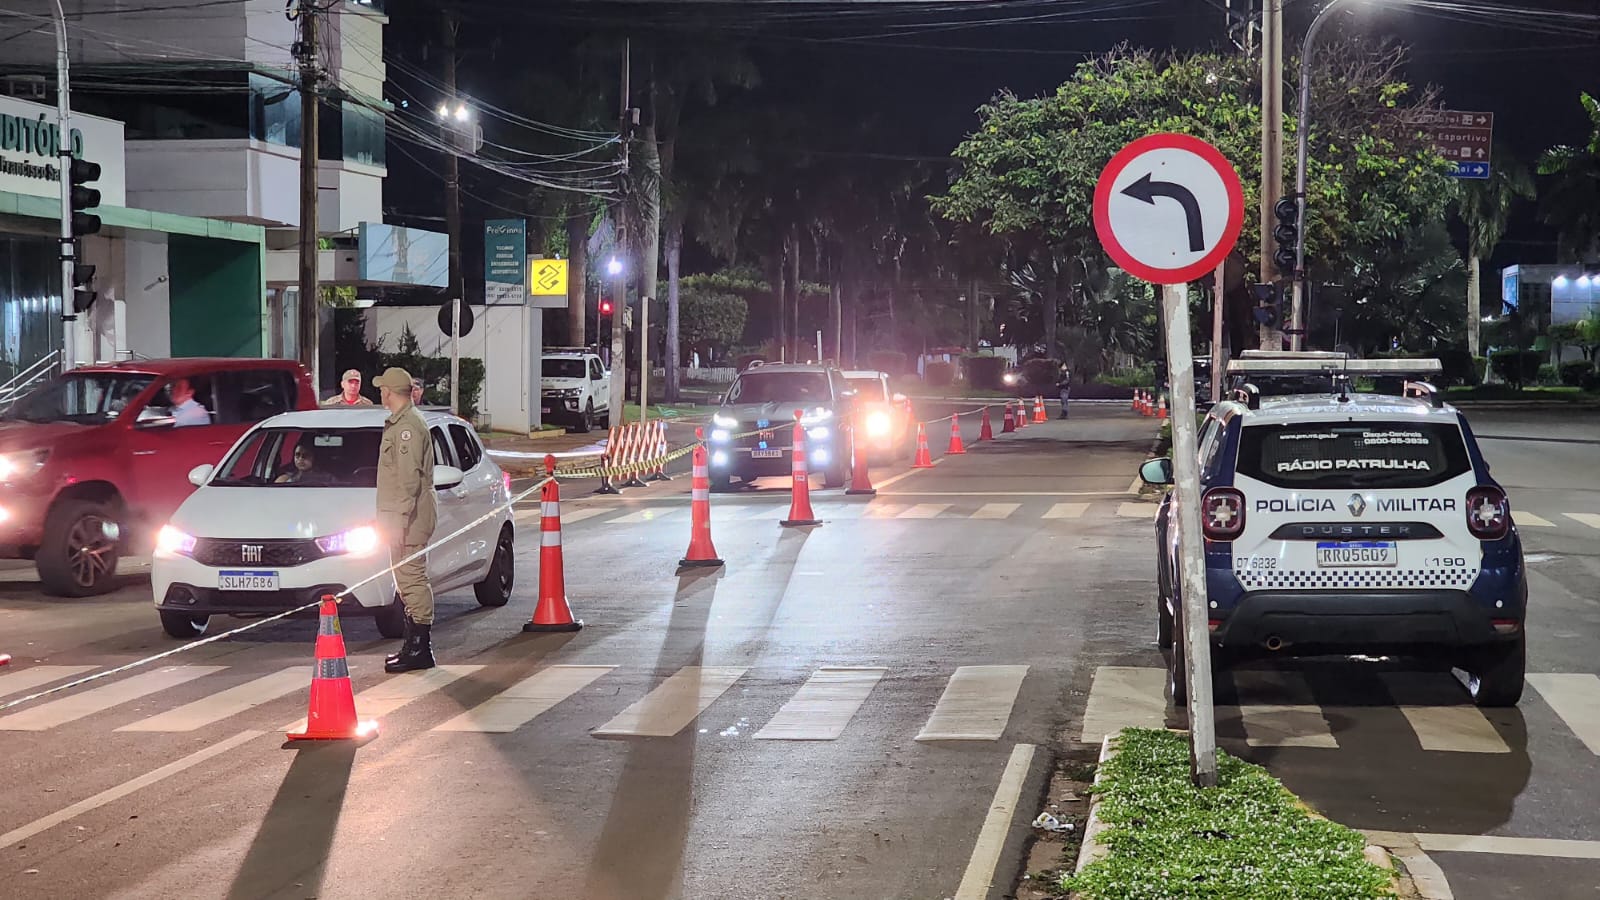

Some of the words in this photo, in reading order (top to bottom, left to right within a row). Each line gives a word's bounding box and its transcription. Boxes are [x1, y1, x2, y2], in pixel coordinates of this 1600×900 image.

[1277, 458, 1333, 472] RÁDIO
[1336, 459, 1430, 470] PATRULHA
[1376, 498, 1456, 512] MILITAR
[1303, 526, 1410, 534] DUSTER
[242, 545, 263, 562] FIAT
[225, 577, 273, 588] SLH7G86
